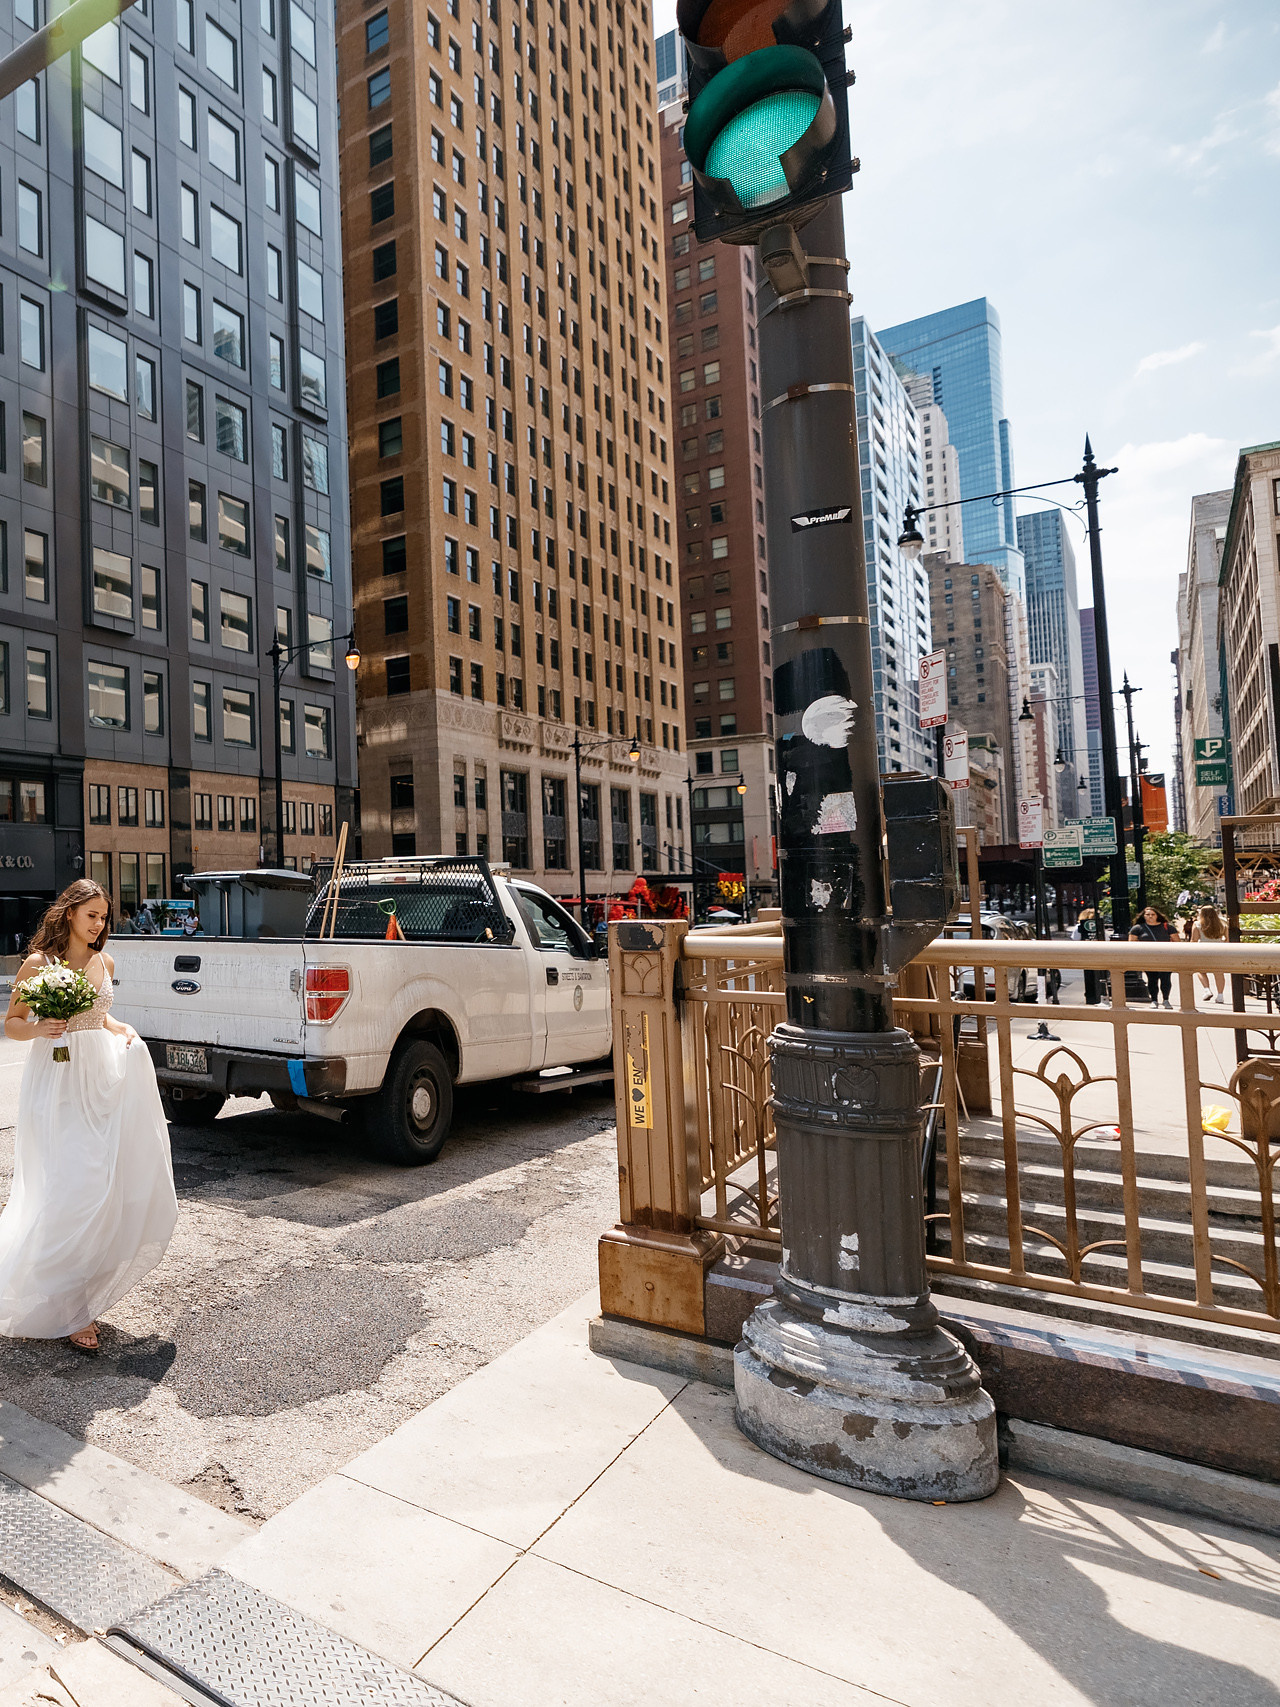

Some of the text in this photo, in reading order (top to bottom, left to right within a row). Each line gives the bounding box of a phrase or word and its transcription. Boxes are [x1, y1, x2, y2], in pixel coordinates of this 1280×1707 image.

[5, 855, 15, 868] &
[17, 855, 35, 868] CO.
[634, 1105, 646, 1124] WE
